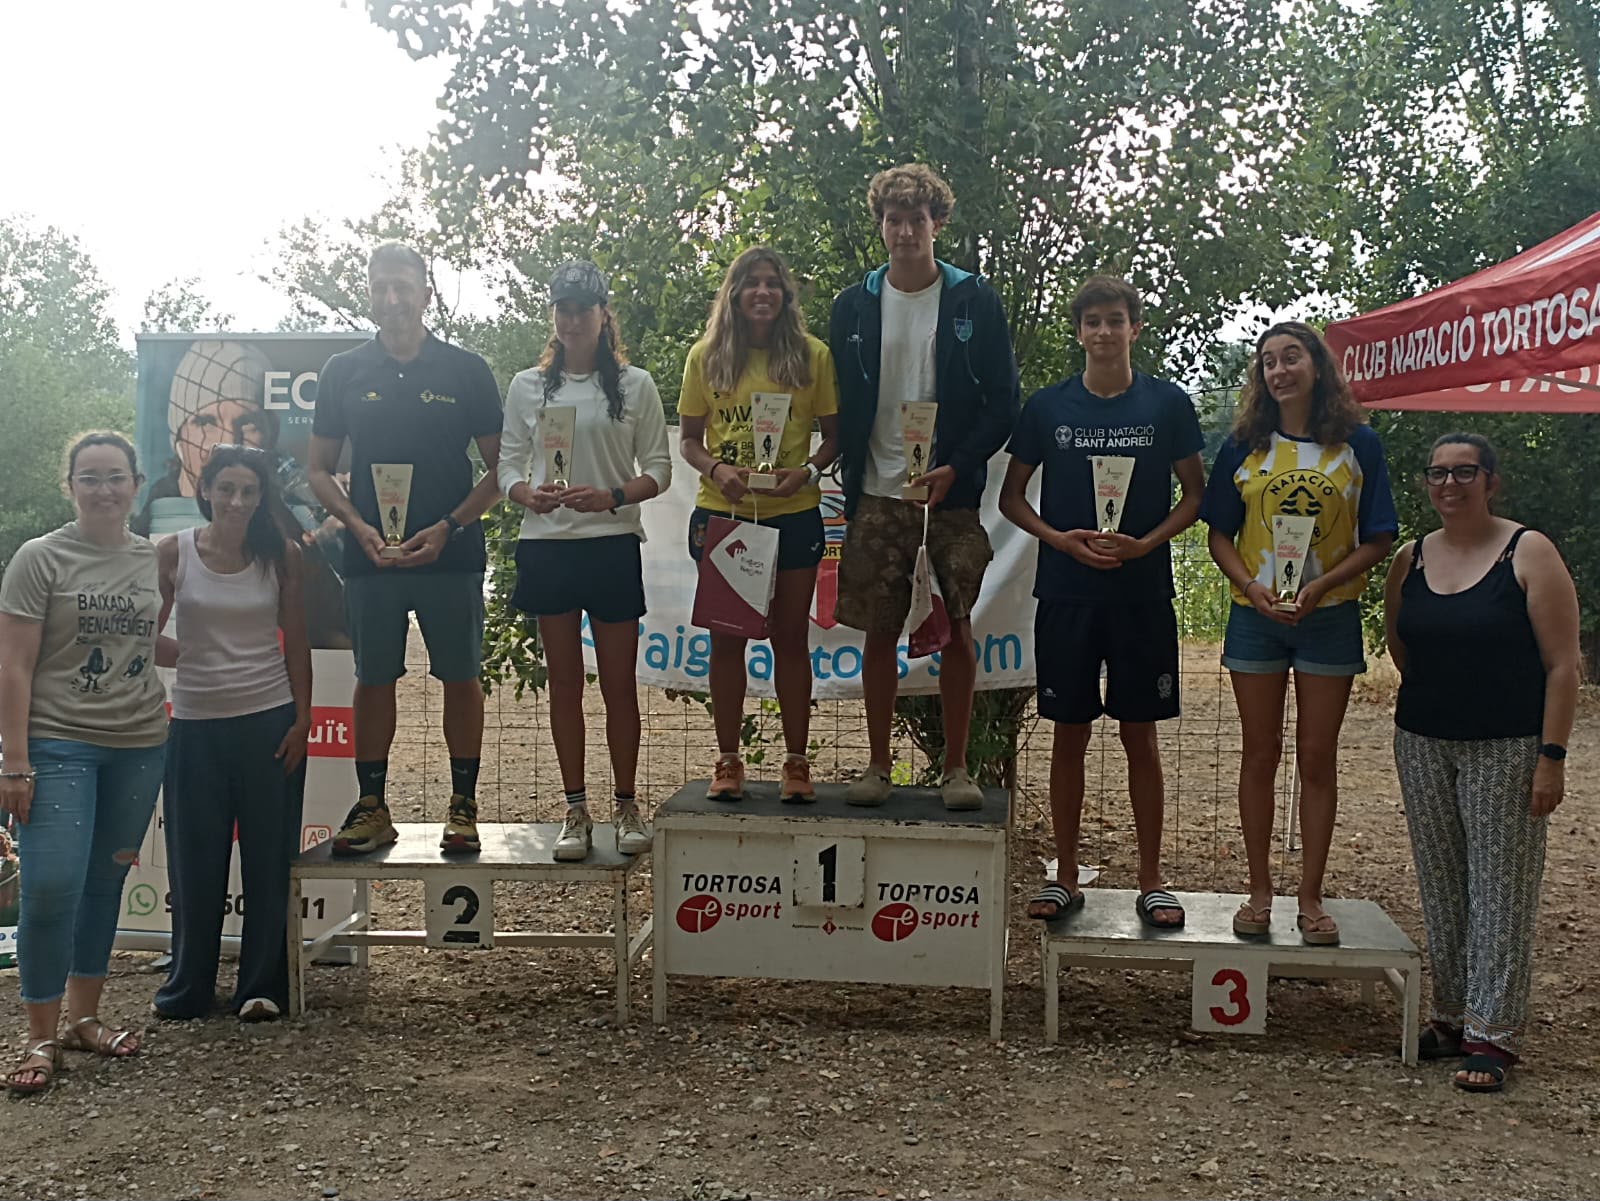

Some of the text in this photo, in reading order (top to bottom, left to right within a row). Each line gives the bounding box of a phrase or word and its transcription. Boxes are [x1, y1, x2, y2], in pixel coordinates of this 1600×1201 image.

[1342, 339, 1387, 384] CLUB
[1391, 304, 1476, 377] NATACIÓ
[1481, 282, 1600, 358] TORTOSA
[1074, 424, 1155, 438] CLUB NATACIÓ
[1074, 436, 1154, 448] SANT ANDREU
[1269, 474, 1335, 496] NATACIÓ
[77, 593, 136, 613] BAIXADA
[682, 873, 782, 894] TORTOSA
[818, 844, 838, 903] 1
[441, 885, 481, 944] 2
[1209, 968, 1251, 1026] 3
